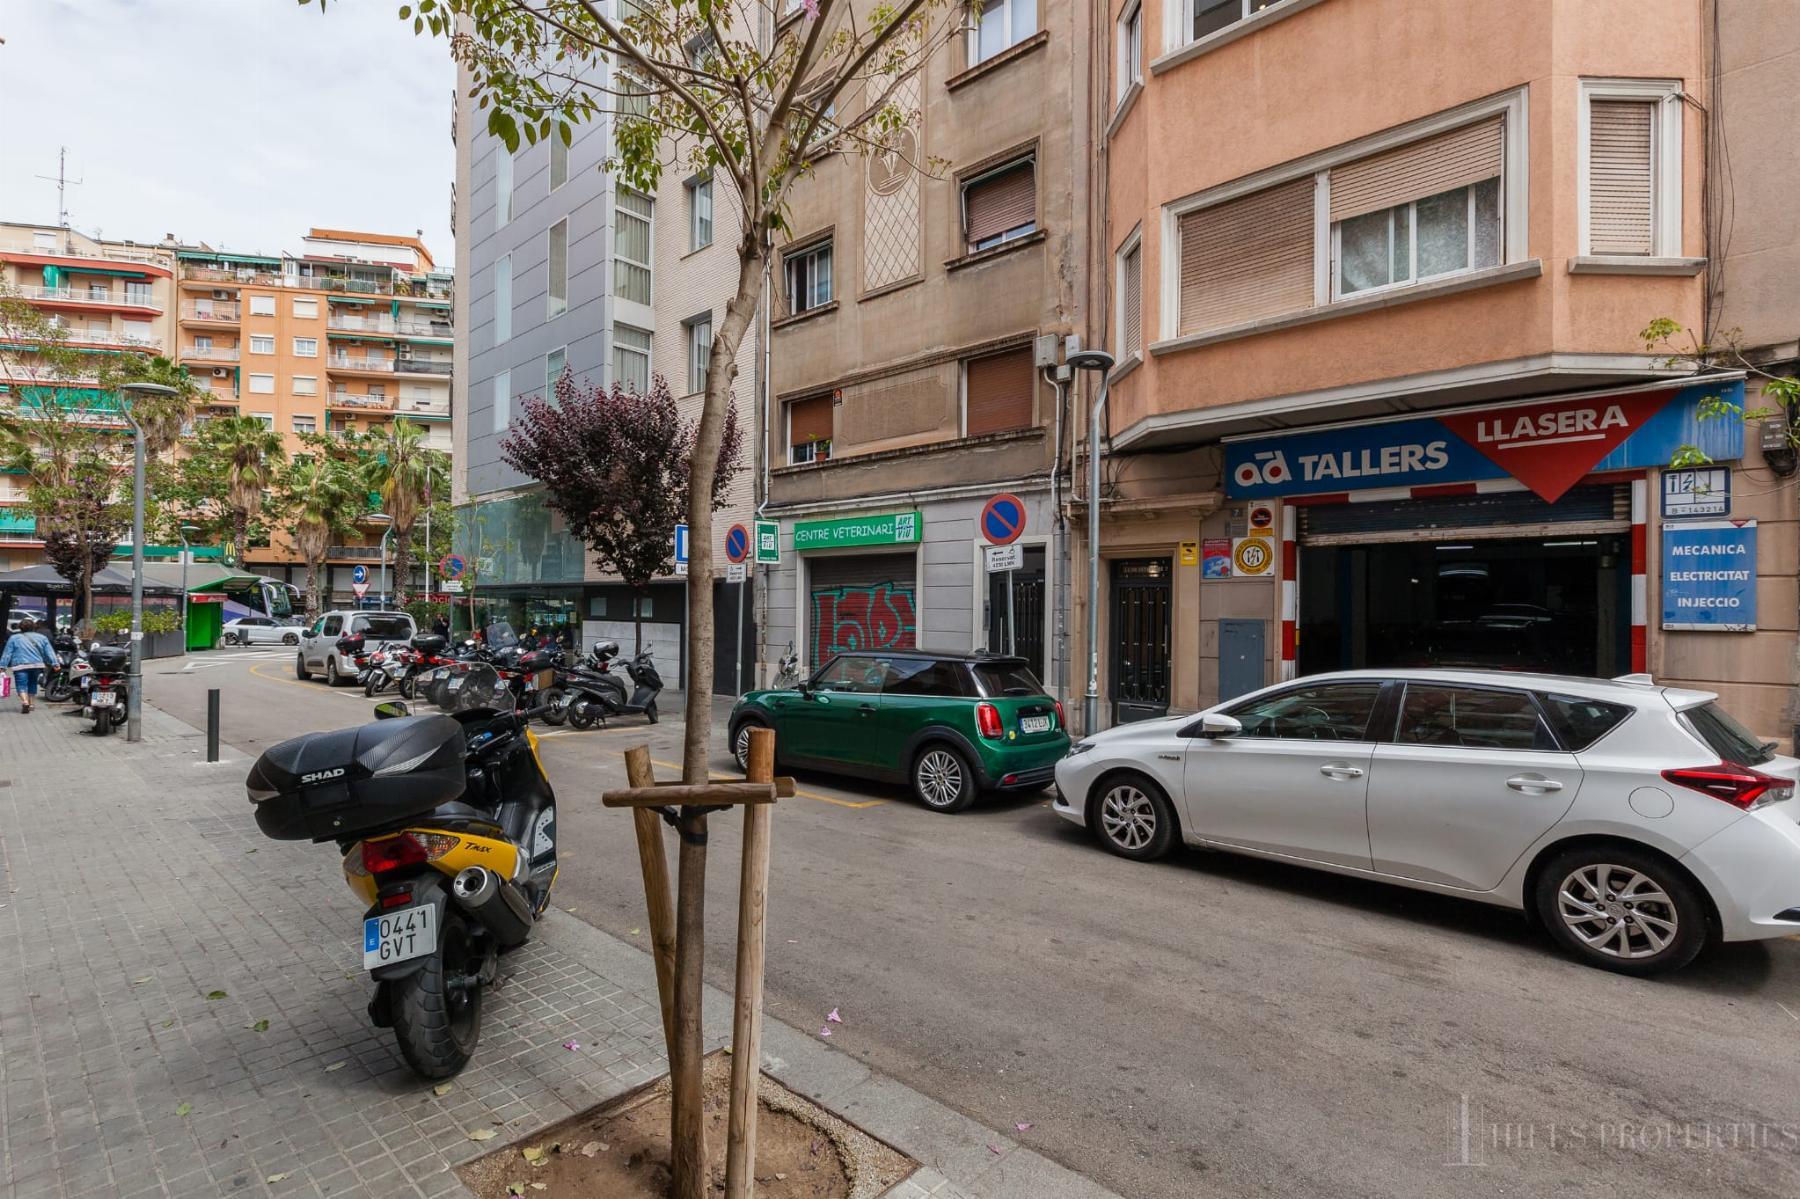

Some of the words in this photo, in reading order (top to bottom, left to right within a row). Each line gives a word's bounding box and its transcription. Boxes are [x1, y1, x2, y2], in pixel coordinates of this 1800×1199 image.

[1477, 405, 1629, 443] LLASERA
[1299, 441, 1449, 481] TALLERS
[897, 516, 912, 525] ART
[795, 528, 830, 542] CENTRE
[833, 523, 894, 539] VETERINARI
[897, 529, 912, 539] VIU
[1672, 544, 1746, 556] MECANICA
[1670, 570, 1750, 582] ELECTRICITAT
[301, 768, 345, 784] SHAD
[380, 909, 428, 939] 0441
[380, 933, 417, 961] GVT
